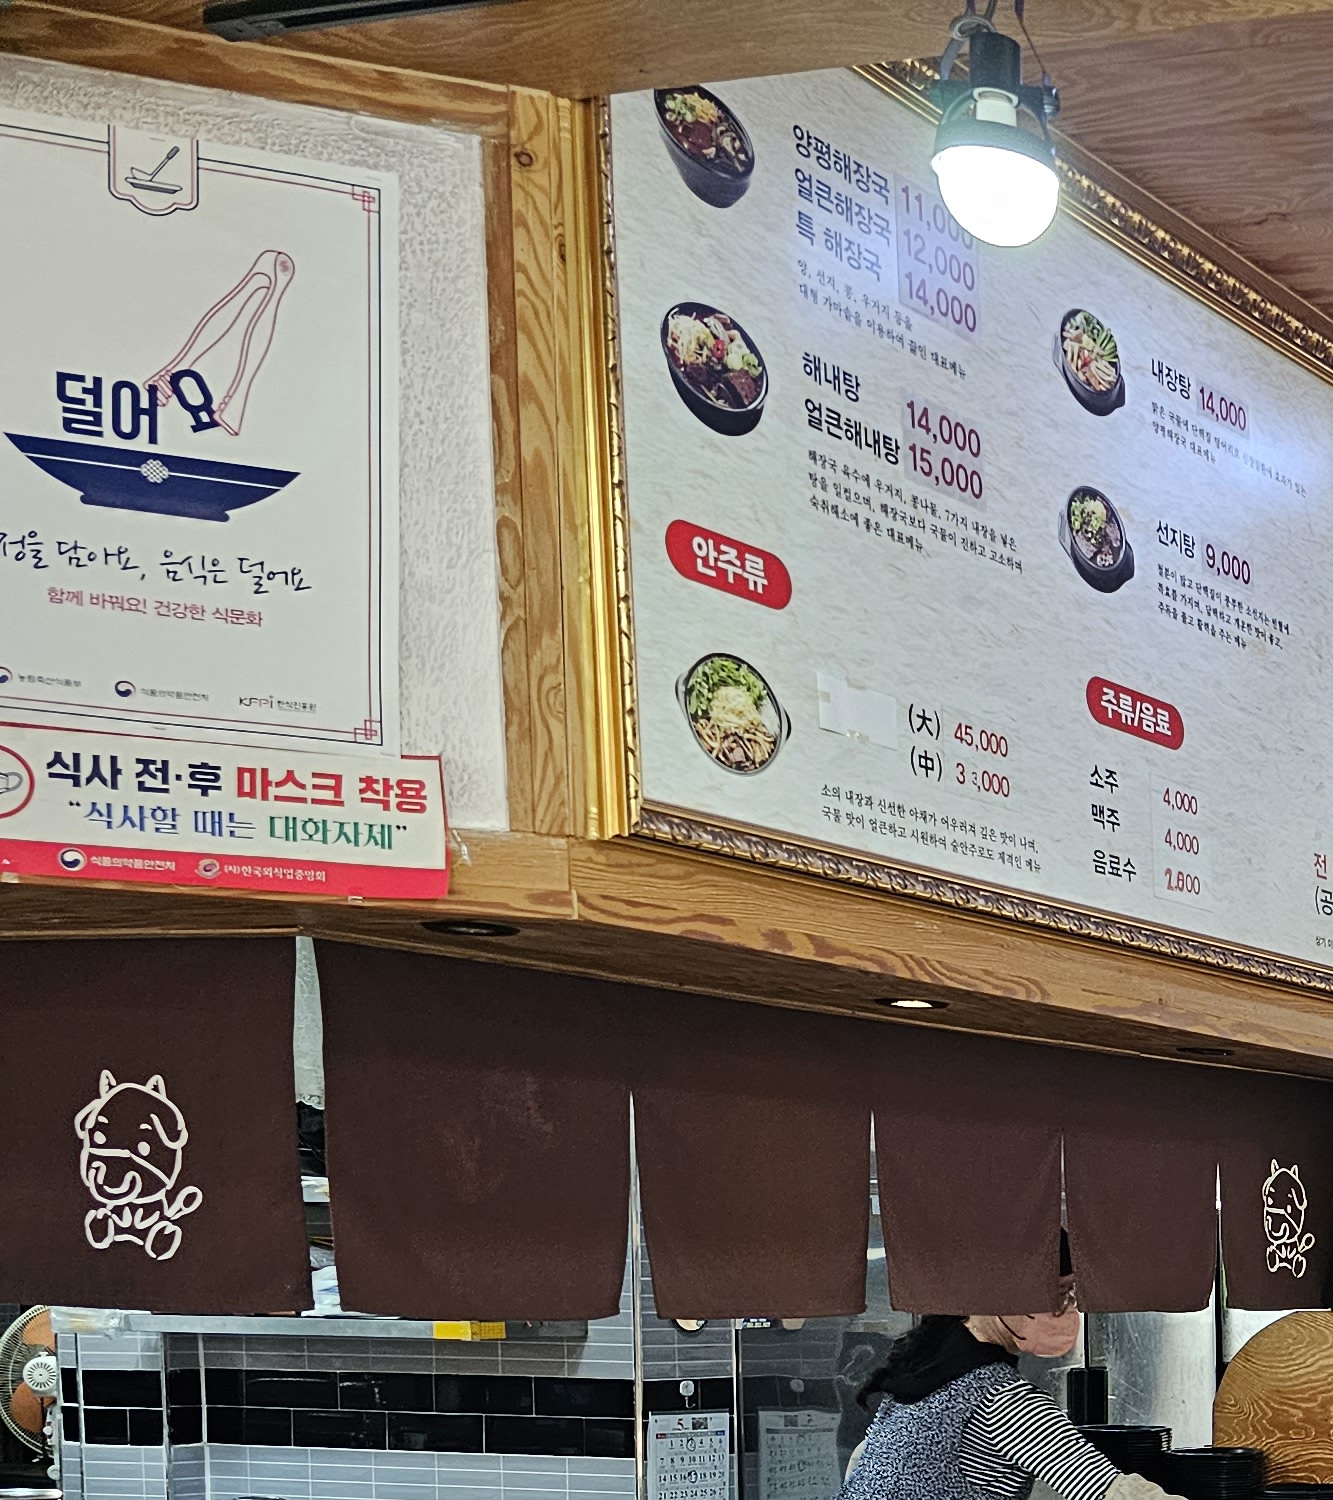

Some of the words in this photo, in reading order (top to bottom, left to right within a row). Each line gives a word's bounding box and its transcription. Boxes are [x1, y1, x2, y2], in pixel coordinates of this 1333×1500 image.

[793, 124, 890, 206] 양평해장국
[795, 168, 891, 247] 얼큰해장국
[903, 228, 975, 292] 12,000
[796, 210, 815, 246] 특
[824, 227, 882, 282] 해장국
[905, 271, 976, 333] 14,000
[931, 345, 967, 379] 대표메뉴
[56, 368, 221, 445] 덜어요
[803, 352, 860, 402] 해내탕
[907, 400, 980, 458] 14,000
[1152, 358, 1191, 400] 내장탕
[1200, 386, 1246, 431] 14,000
[805, 399, 900, 466] 얼큰해내탕
[909, 443, 983, 499] 15,000
[692, 536, 768, 594] 안주류
[887, 528, 924, 553] 대표메뉴
[1156, 520, 1195, 558] 선지탕
[1206, 543, 1250, 585] 9,000
[57, 540, 147, 581] 담아요,
[160, 550, 228, 585] 음식은
[237, 557, 312, 594] 덜어요
[47, 586, 84, 607] 함께
[89, 591, 147, 615] 바꿔요!
[154, 600, 206, 622] 건강한
[212, 607, 263, 627] 식문화
[908, 703, 940, 740] (大)
[954, 723, 1008, 757] 45,000
[1100, 687, 1171, 736] 주류/음료
[46, 751, 123, 791] 식사
[135, 757, 222, 797] 전·후
[237, 766, 344, 808] 마스크
[358, 776, 428, 815] 착용
[910, 746, 942, 782] (中)
[1090, 764, 1118, 794] 소주
[1163, 788, 1198, 815] 4,000
[194, 810, 256, 841] 때는
[1091, 804, 1120, 832] 맥주
[1164, 828, 1199, 855] 4,000
[90, 855, 176, 872] 식품의약품안전처
[1092, 849, 1137, 882] 음료수
[1314, 853, 1327, 880] 전
[677, 1418, 684, 1431] 5
